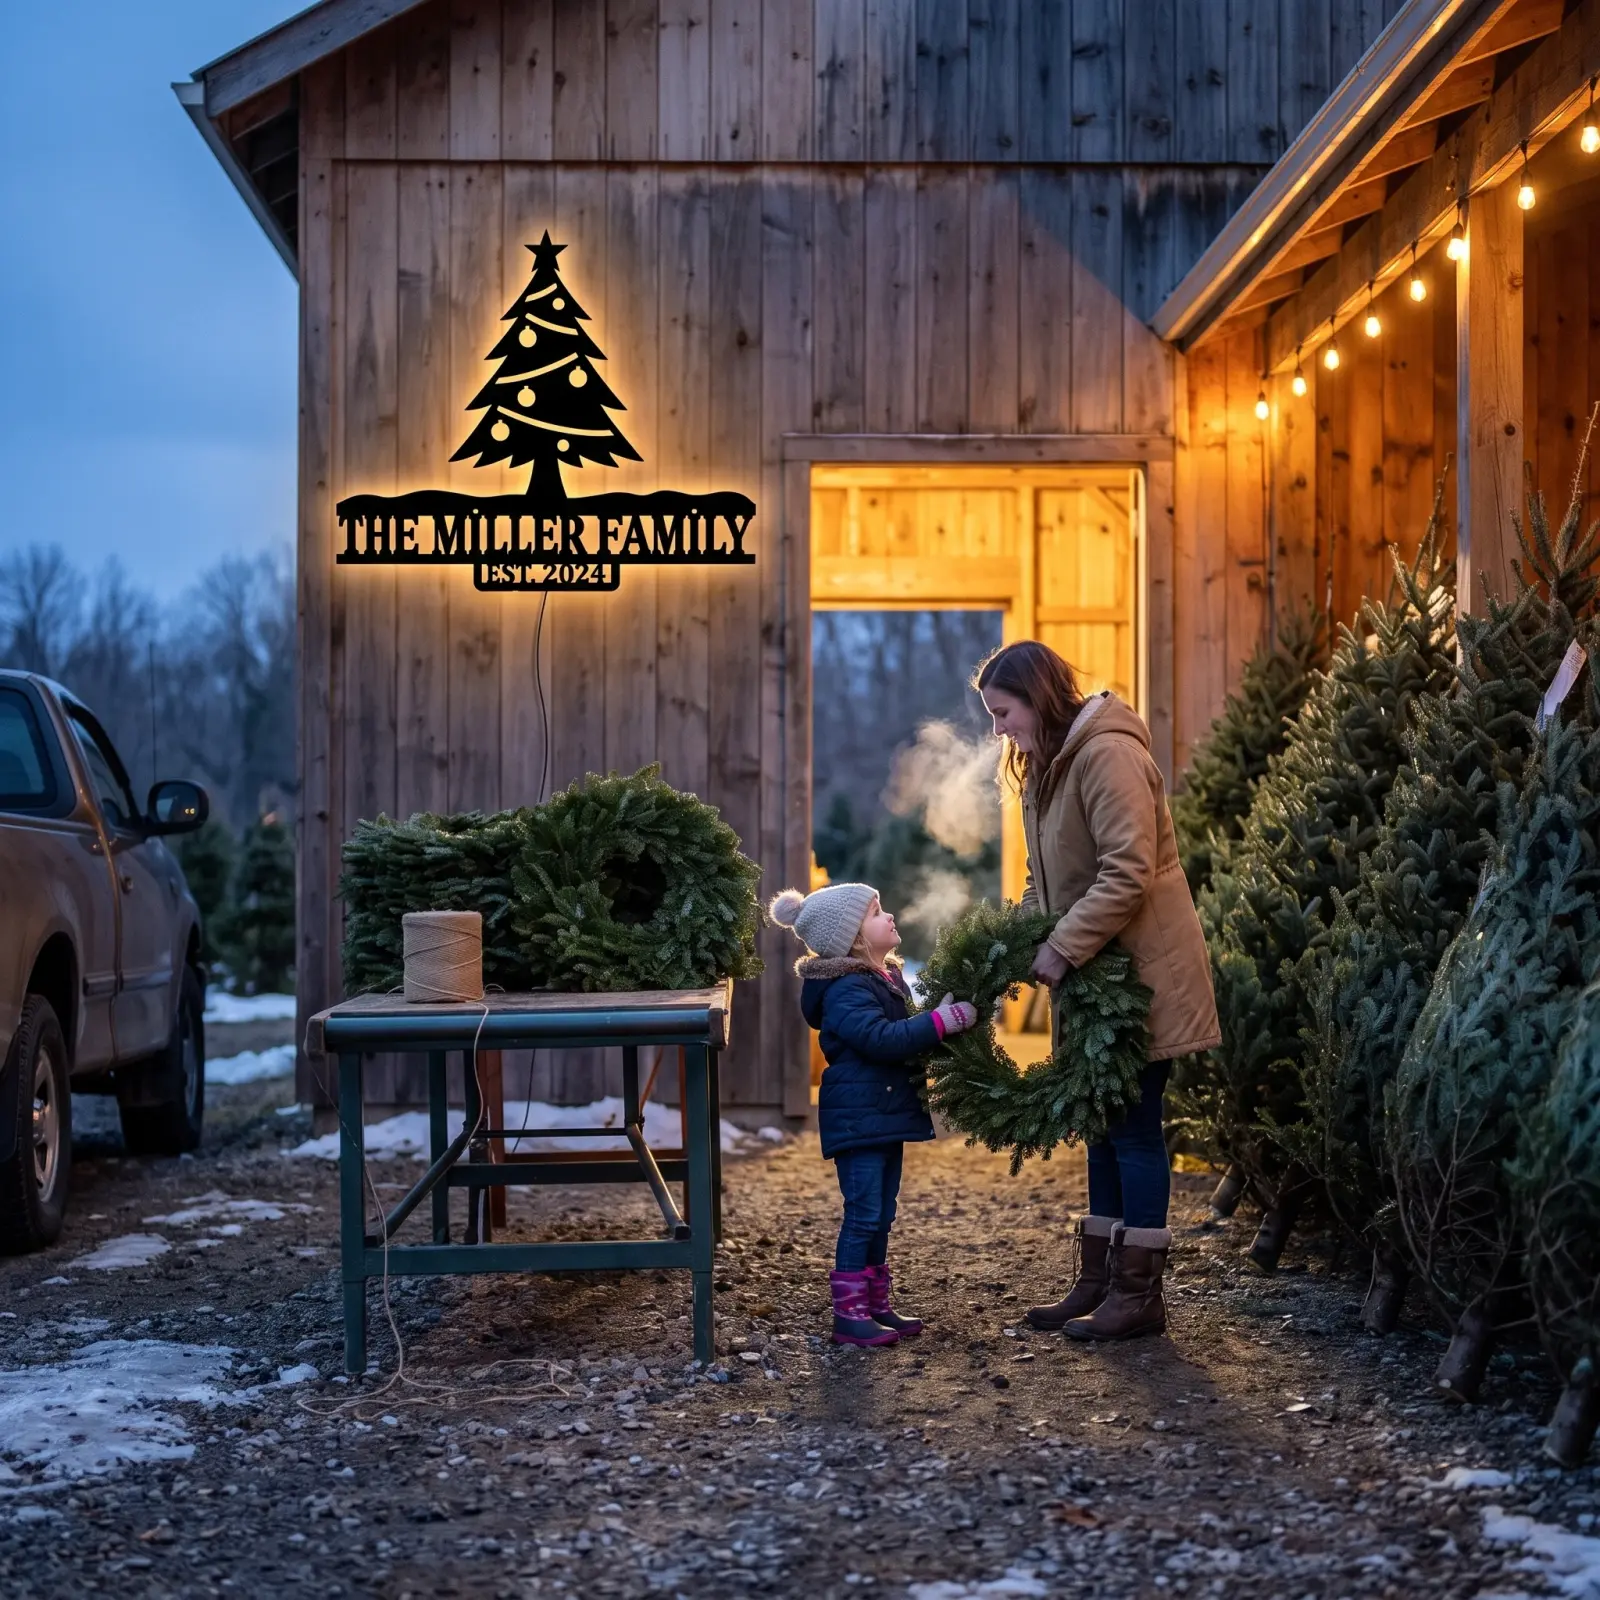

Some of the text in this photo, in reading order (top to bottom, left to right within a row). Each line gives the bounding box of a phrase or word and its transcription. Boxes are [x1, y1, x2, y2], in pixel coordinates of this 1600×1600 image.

[338, 514, 419, 556] THE
[487, 563, 606, 584] EST. 2024
